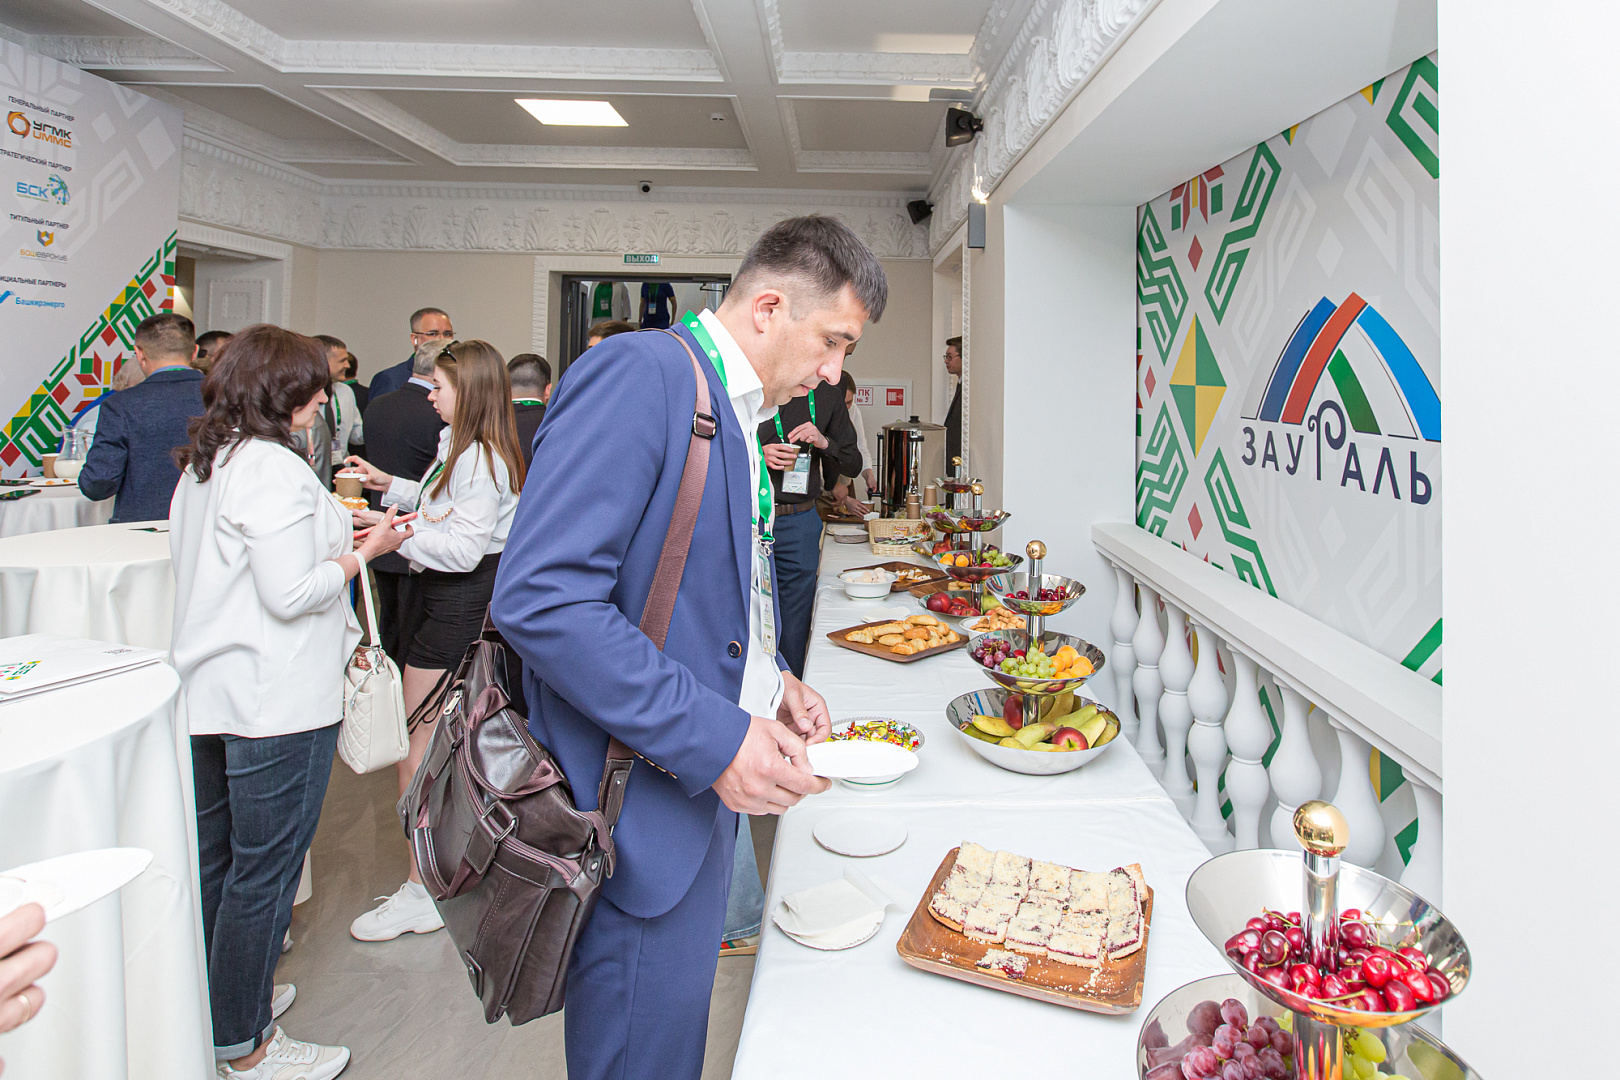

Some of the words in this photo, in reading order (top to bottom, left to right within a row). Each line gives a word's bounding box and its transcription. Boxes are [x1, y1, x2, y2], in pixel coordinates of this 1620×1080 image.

[8, 95, 50, 114] ГЕНЕРАЛЬНЫЙ
[50, 109, 75, 122] ПАРТНЕР
[33, 120, 72, 140] УГМК
[33, 130, 72, 148] UMMC
[47, 161, 72, 172] ПАРТНЕР
[16, 181, 49, 199] БСК
[10, 213, 45, 225] ТИТУЛЬНЫЙ
[45, 219, 69, 230] ПАРТНЕР
[625, 255, 657, 263] ВЫХОД
[37, 279, 67, 288] ПАРТНЕРЫ
[15, 296, 66, 309] Башкирэнерго
[1241, 400, 1432, 505] ЗАУРАЛЬ
